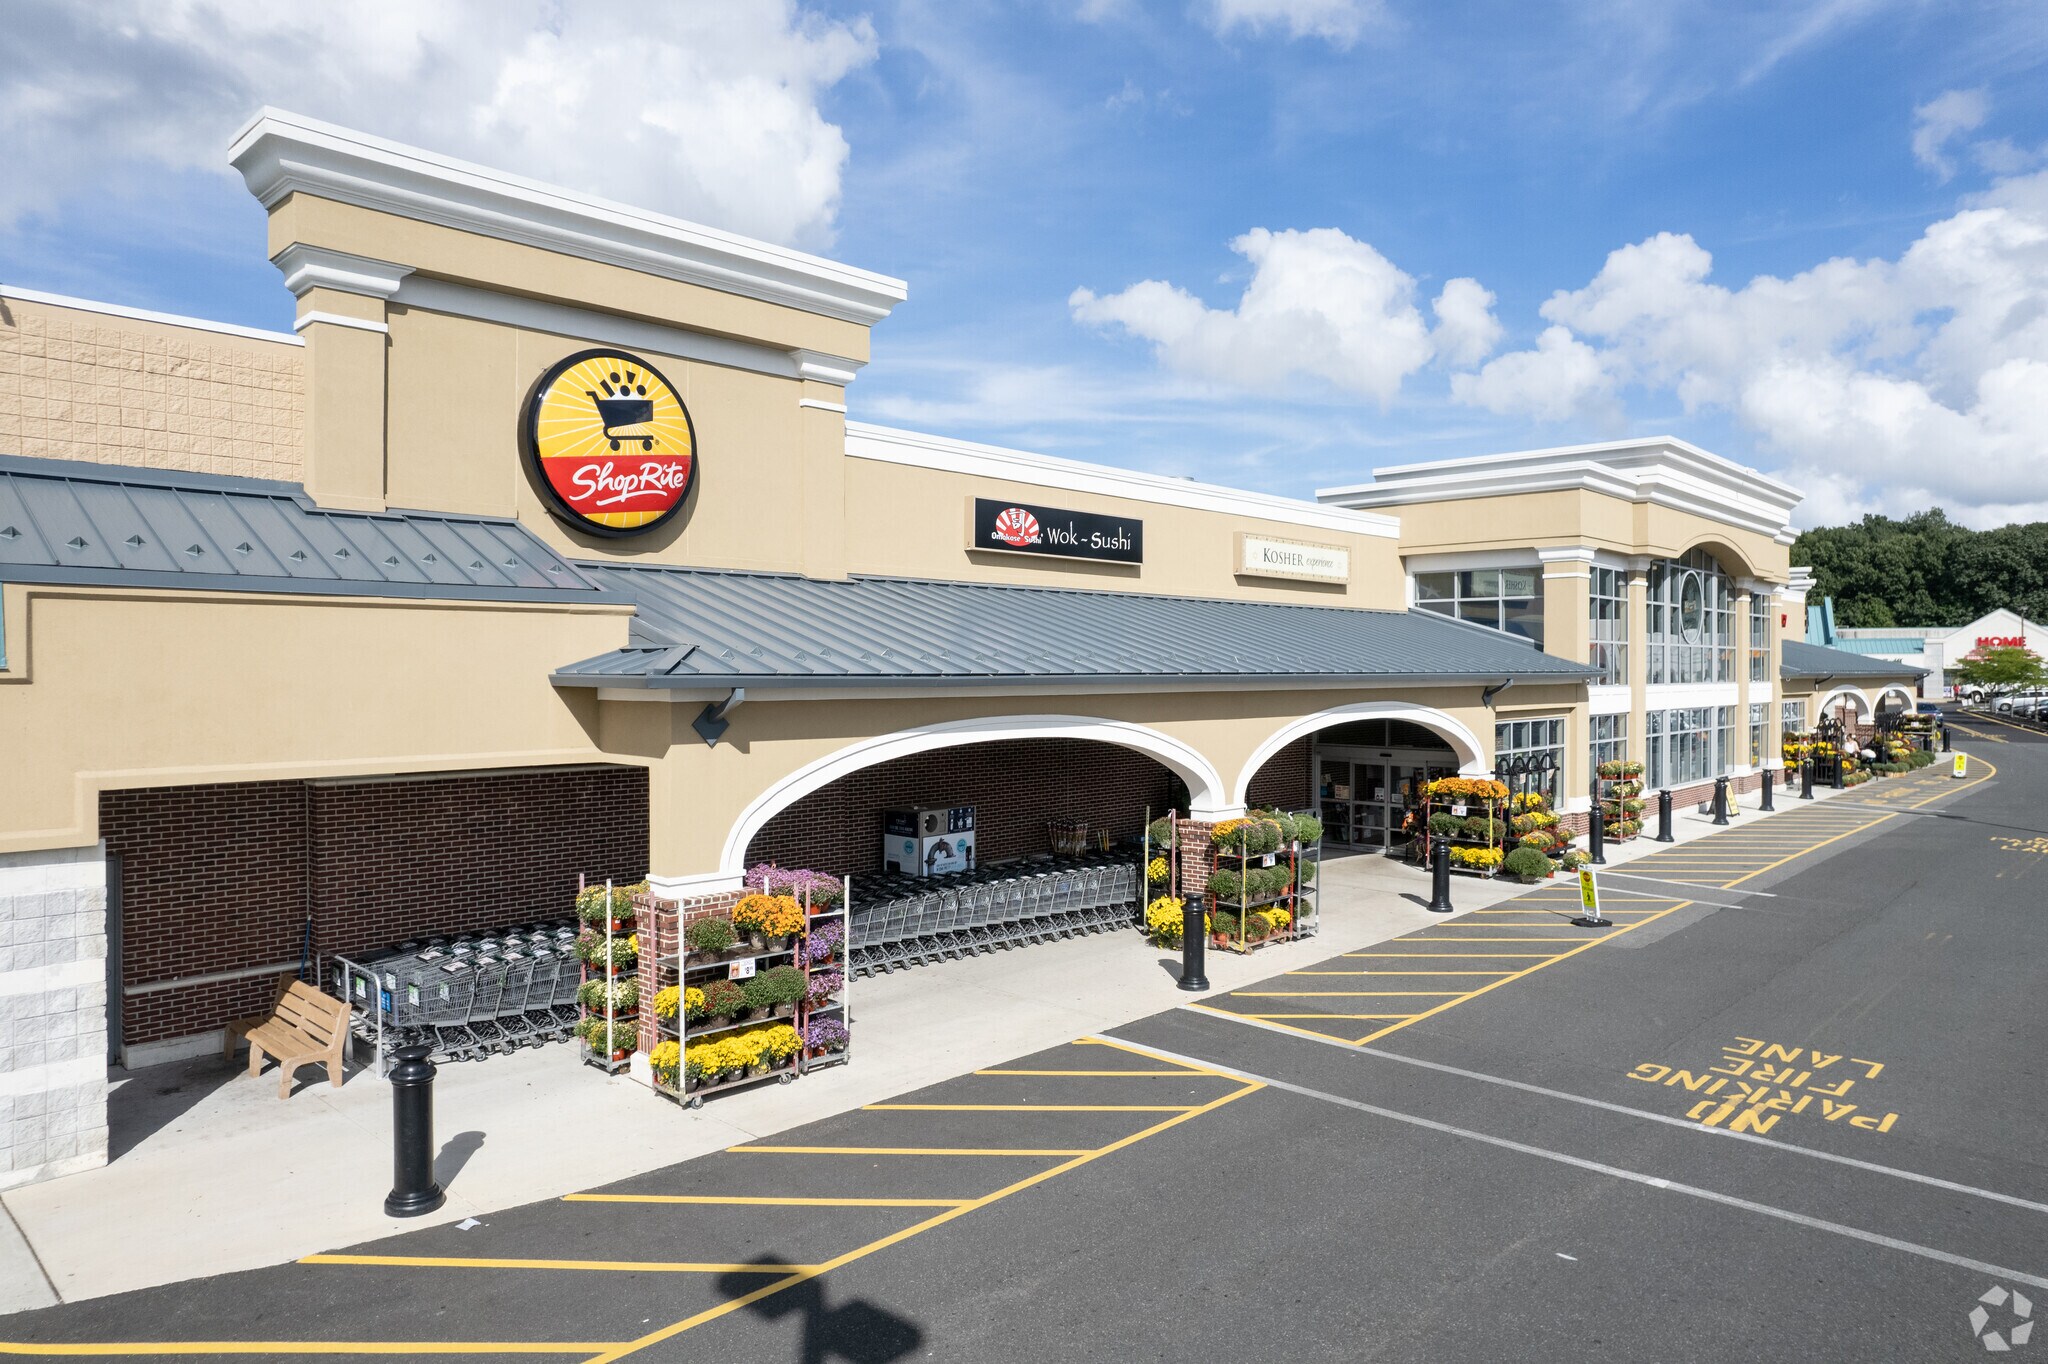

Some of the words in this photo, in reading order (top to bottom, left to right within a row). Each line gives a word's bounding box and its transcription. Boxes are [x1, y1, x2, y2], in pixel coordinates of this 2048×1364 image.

[569, 461, 684, 503] ShopRite
[991, 532, 1021, 542] Omakase
[1024, 535, 1042, 545] Sushi
[1046, 521, 1079, 545] Wok
[1090, 526, 1131, 550] Sushi
[1263, 547, 1304, 567] KOSHER
[1977, 636, 2027, 647] HOME
[1722, 1036, 1885, 1080] LANE
[1709, 1055, 1856, 1097] FIRE
[1626, 1063, 1899, 1133] PARKING
